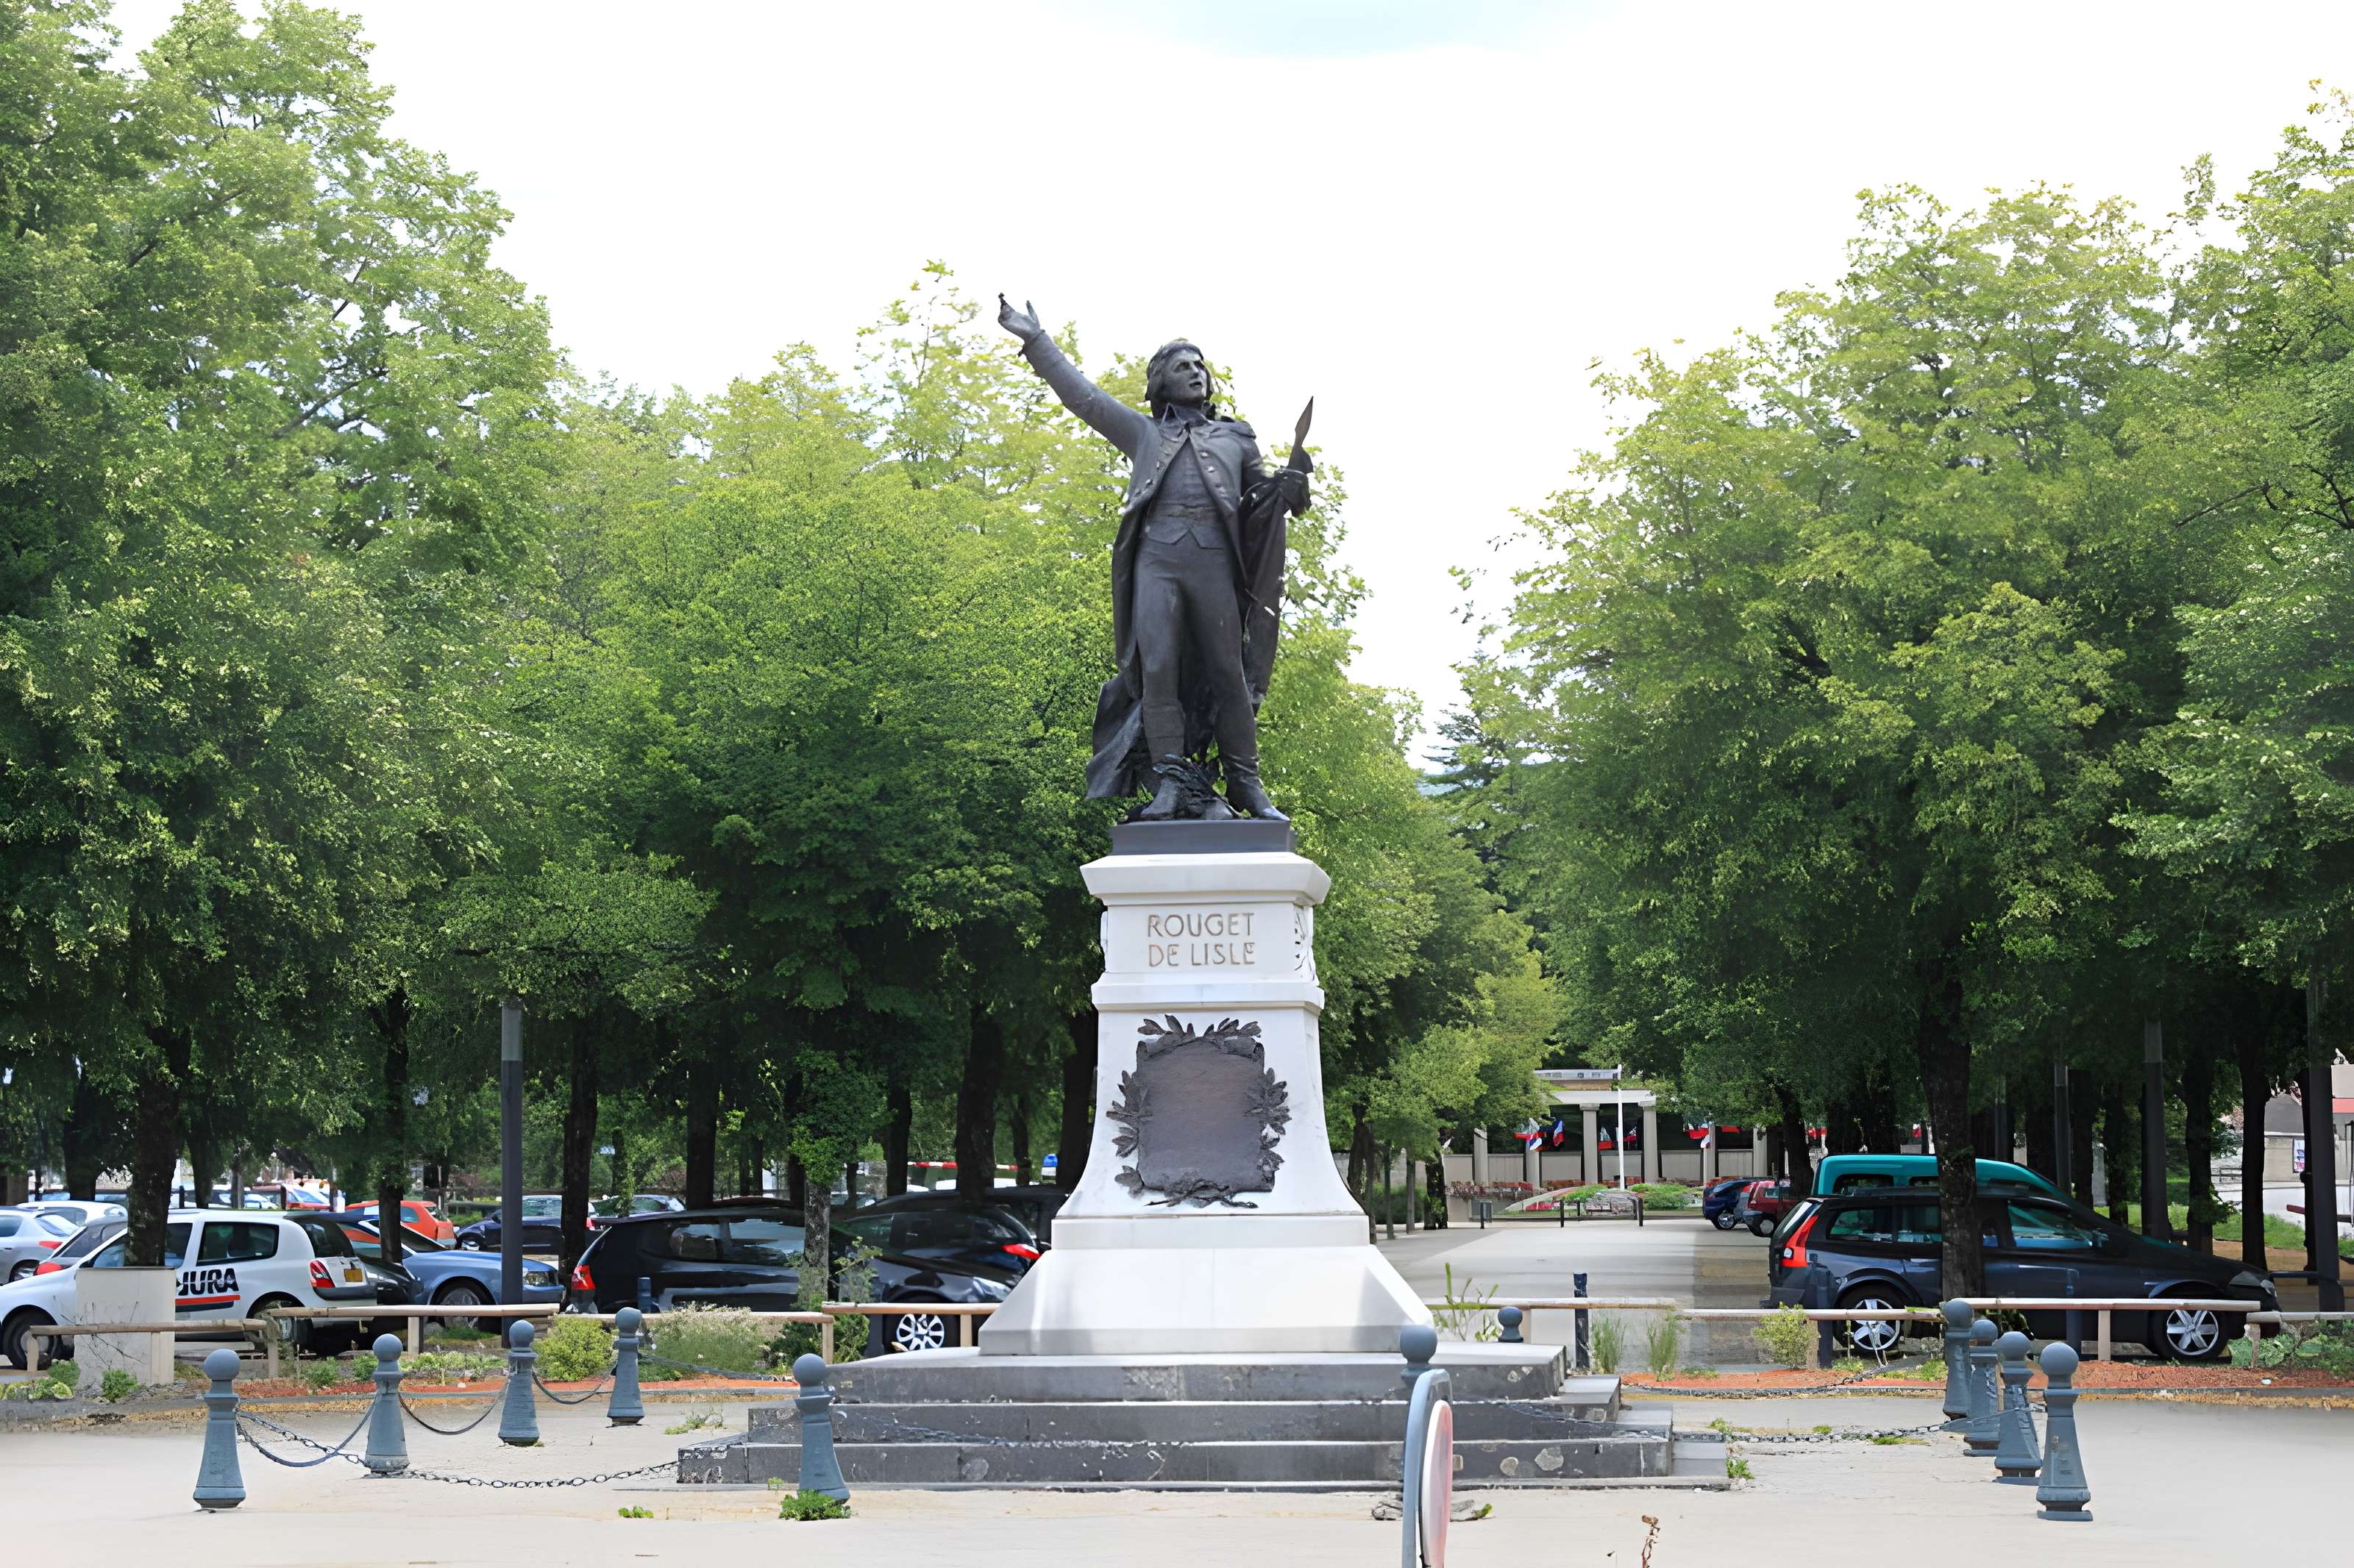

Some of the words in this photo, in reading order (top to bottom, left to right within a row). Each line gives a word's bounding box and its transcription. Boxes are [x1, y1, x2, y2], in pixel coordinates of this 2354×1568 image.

[1148, 913, 1254, 937] ROUGET
[1148, 944, 1178, 967] DE
[1191, 942, 1255, 966] LISLE
[177, 1268, 239, 1296] JURA
